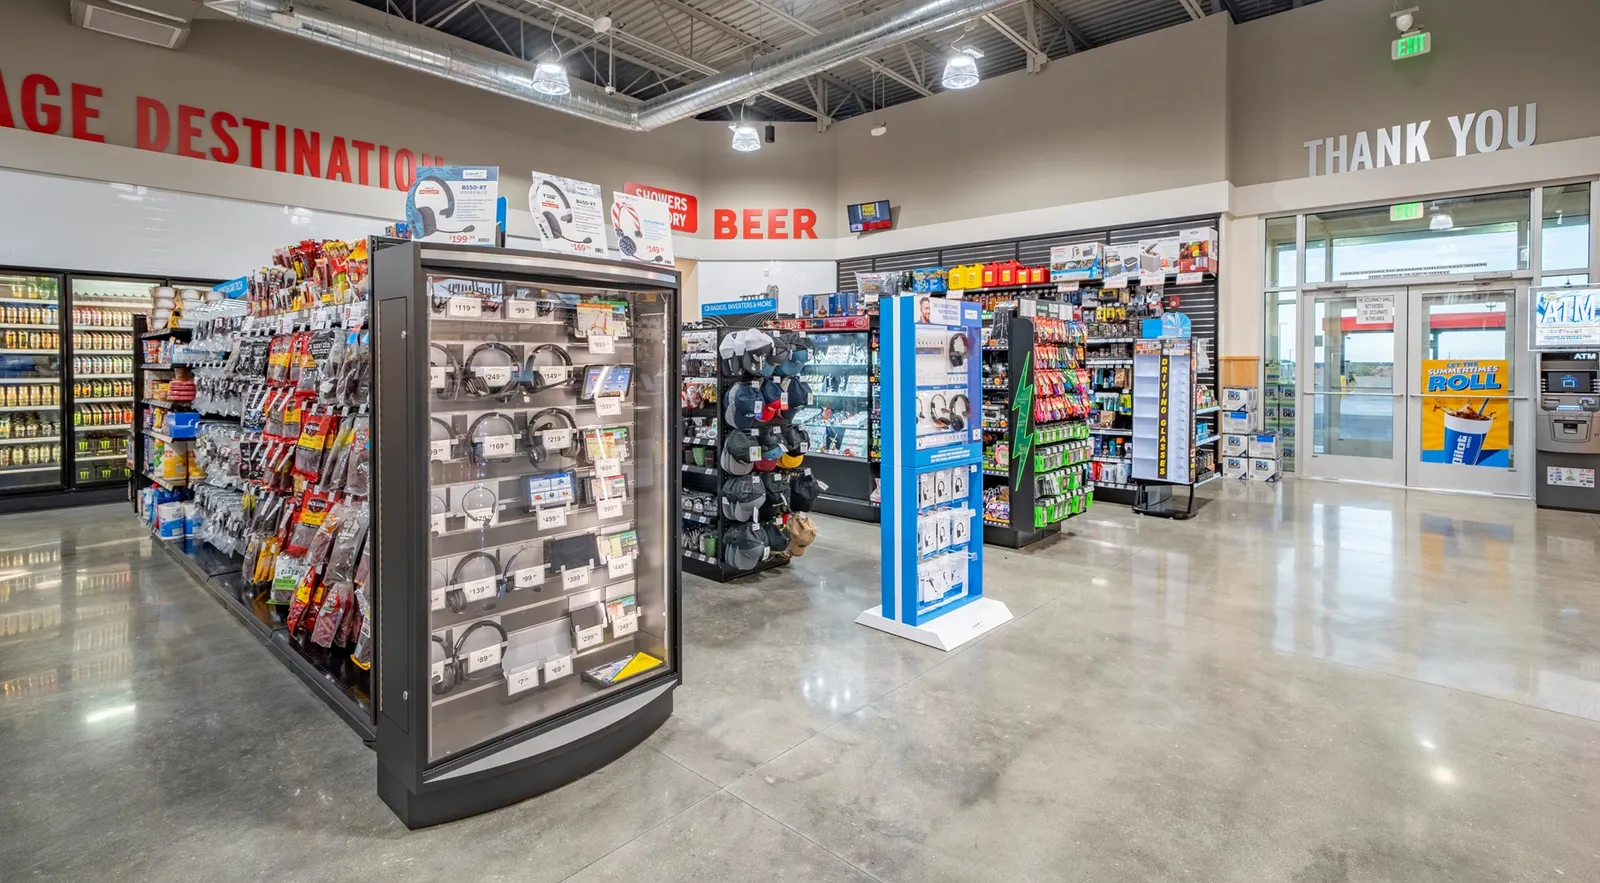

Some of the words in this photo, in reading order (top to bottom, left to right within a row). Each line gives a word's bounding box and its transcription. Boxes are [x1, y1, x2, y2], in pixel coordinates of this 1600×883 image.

[1397, 34, 1426, 57] EXIT
[136, 95, 444, 192] DESTINATIO
[1302, 120, 1431, 178] THANK
[1447, 102, 1537, 158] YOU
[714, 208, 818, 240] BEER
[728, 301, 752, 309] INVERTERS
[1540, 293, 1597, 324] ATM
[1161, 358, 1169, 414] DRIVING
[1428, 366, 1499, 375] SUMMERTIMES
[1428, 373, 1501, 392] ROLL
[1159, 419, 1168, 476] GLASSES
